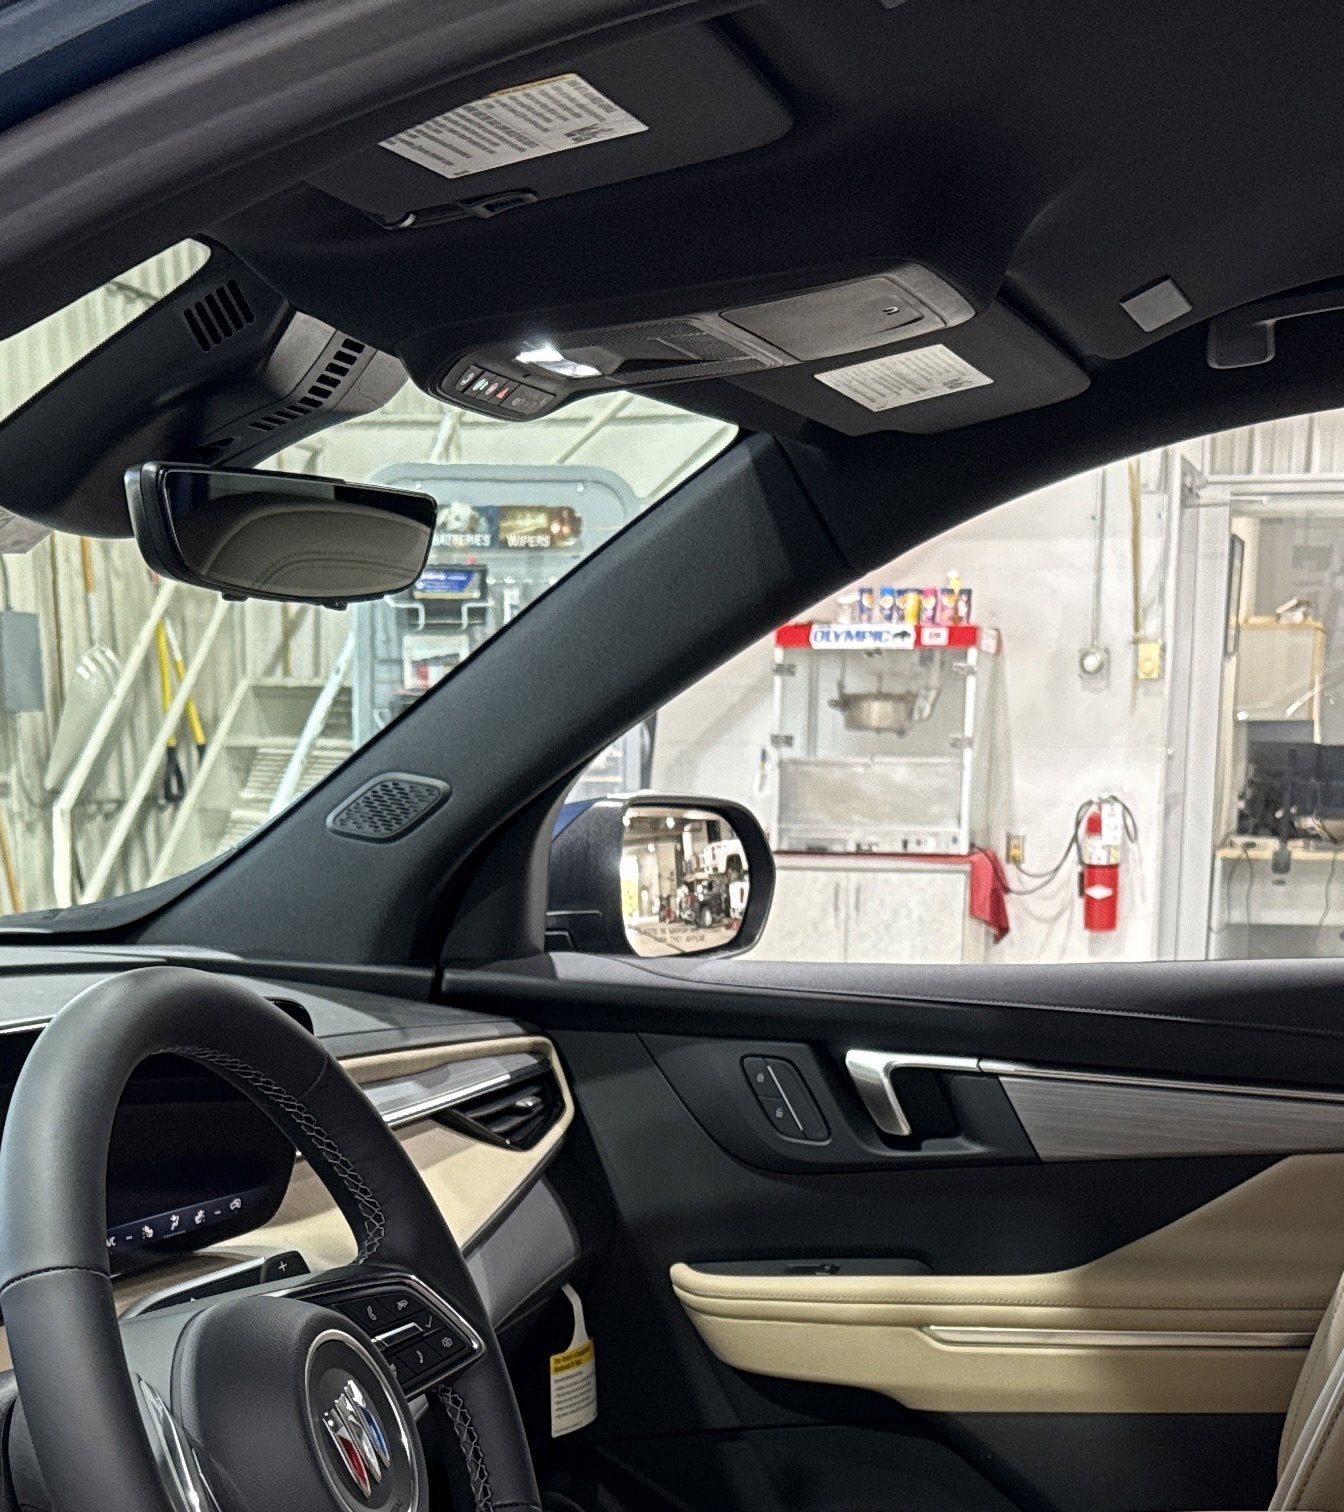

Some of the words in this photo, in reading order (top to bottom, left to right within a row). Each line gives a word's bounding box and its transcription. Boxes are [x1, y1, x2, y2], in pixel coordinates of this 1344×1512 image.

[431, 534, 492, 547] ATTERIES
[506, 534, 551, 547] WIPERS
[813, 629, 891, 644] OLYMPIC
